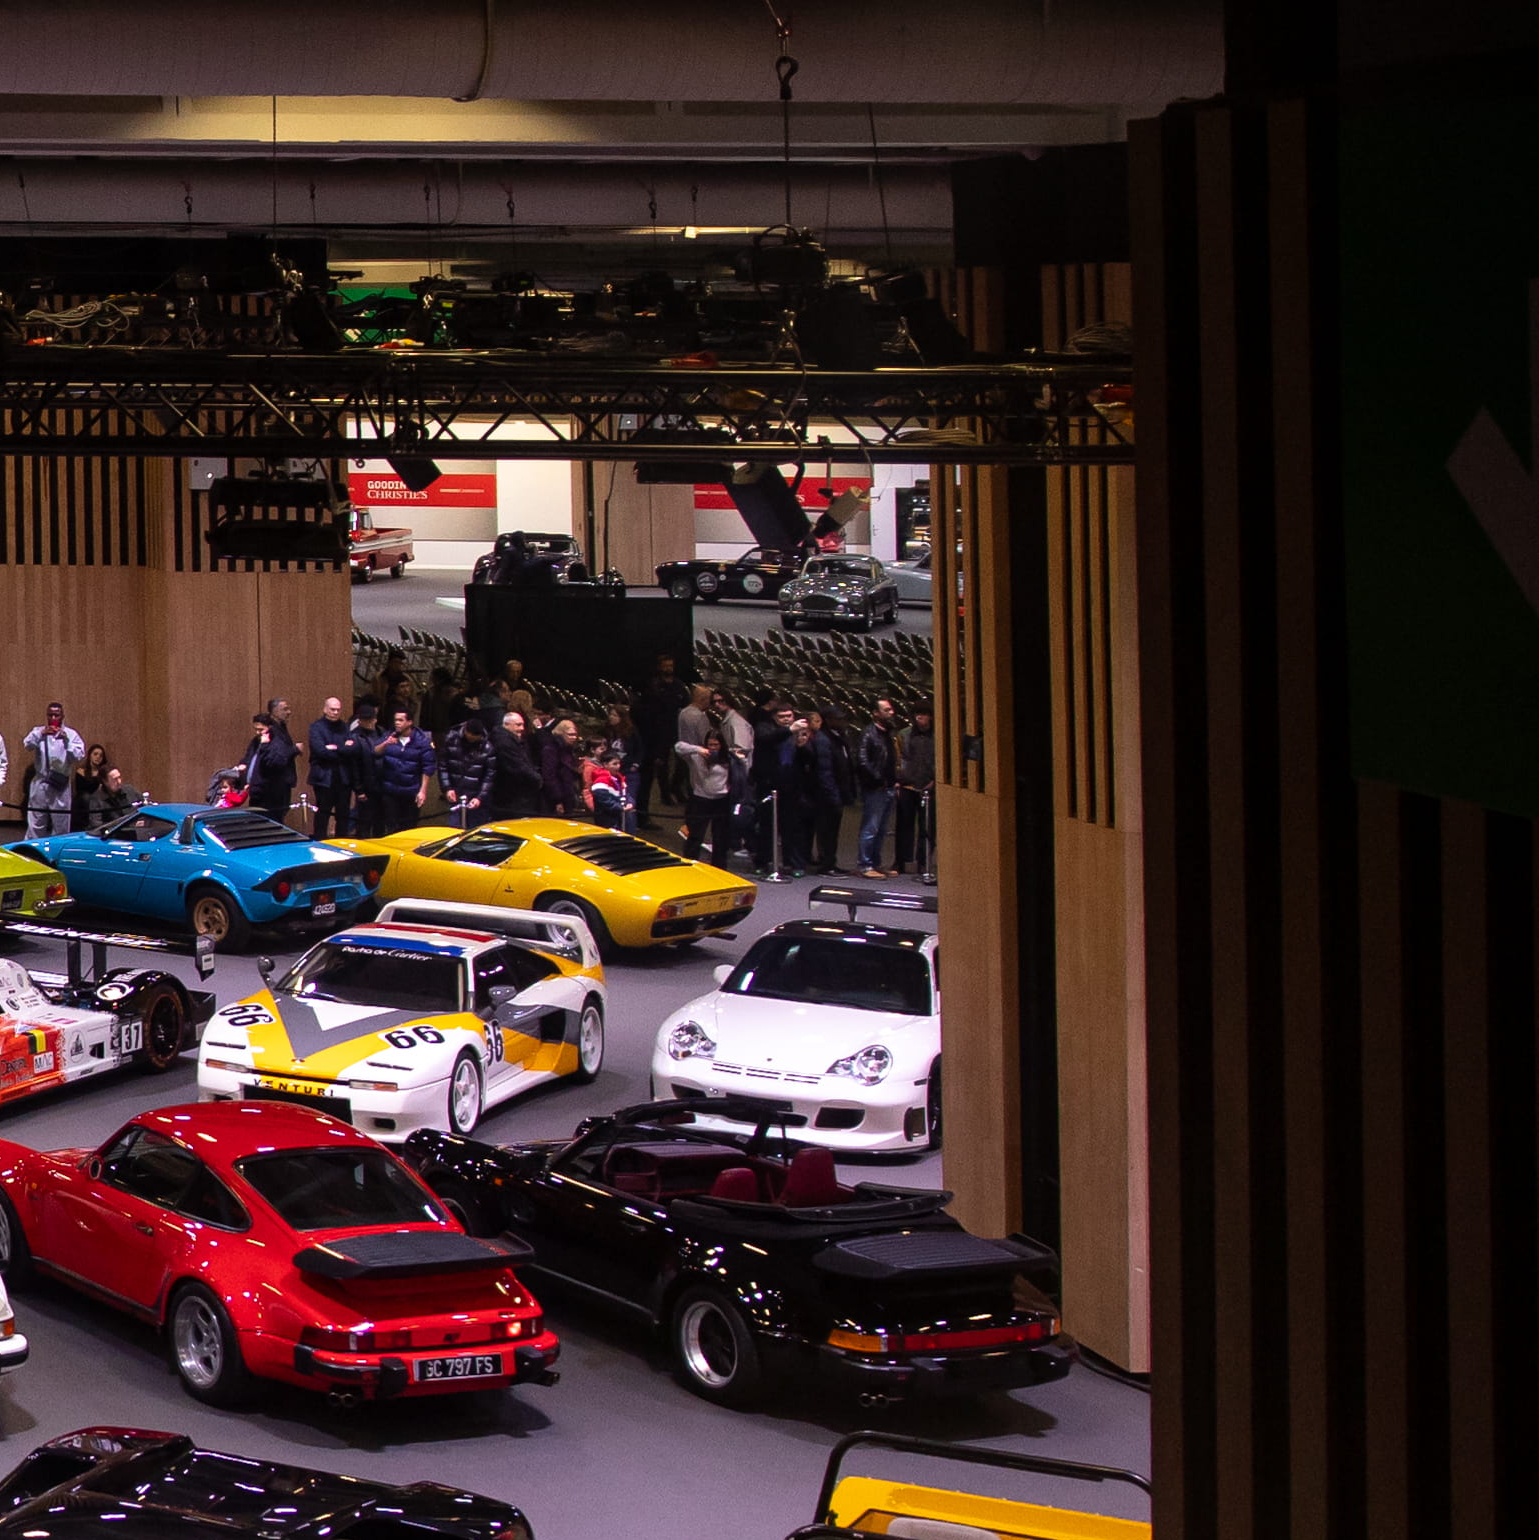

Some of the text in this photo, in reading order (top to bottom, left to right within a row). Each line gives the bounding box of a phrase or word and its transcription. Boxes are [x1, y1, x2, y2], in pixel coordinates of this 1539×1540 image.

[367, 481, 408, 490] GOODIN
[218, 1003, 274, 1027] 66
[124, 1024, 141, 1051] 37
[384, 1024, 446, 1050] 66
[252, 1079, 335, 1098] VENTURI
[445, 1358, 472, 1376] 797
[475, 1356, 494, 1374] FS
